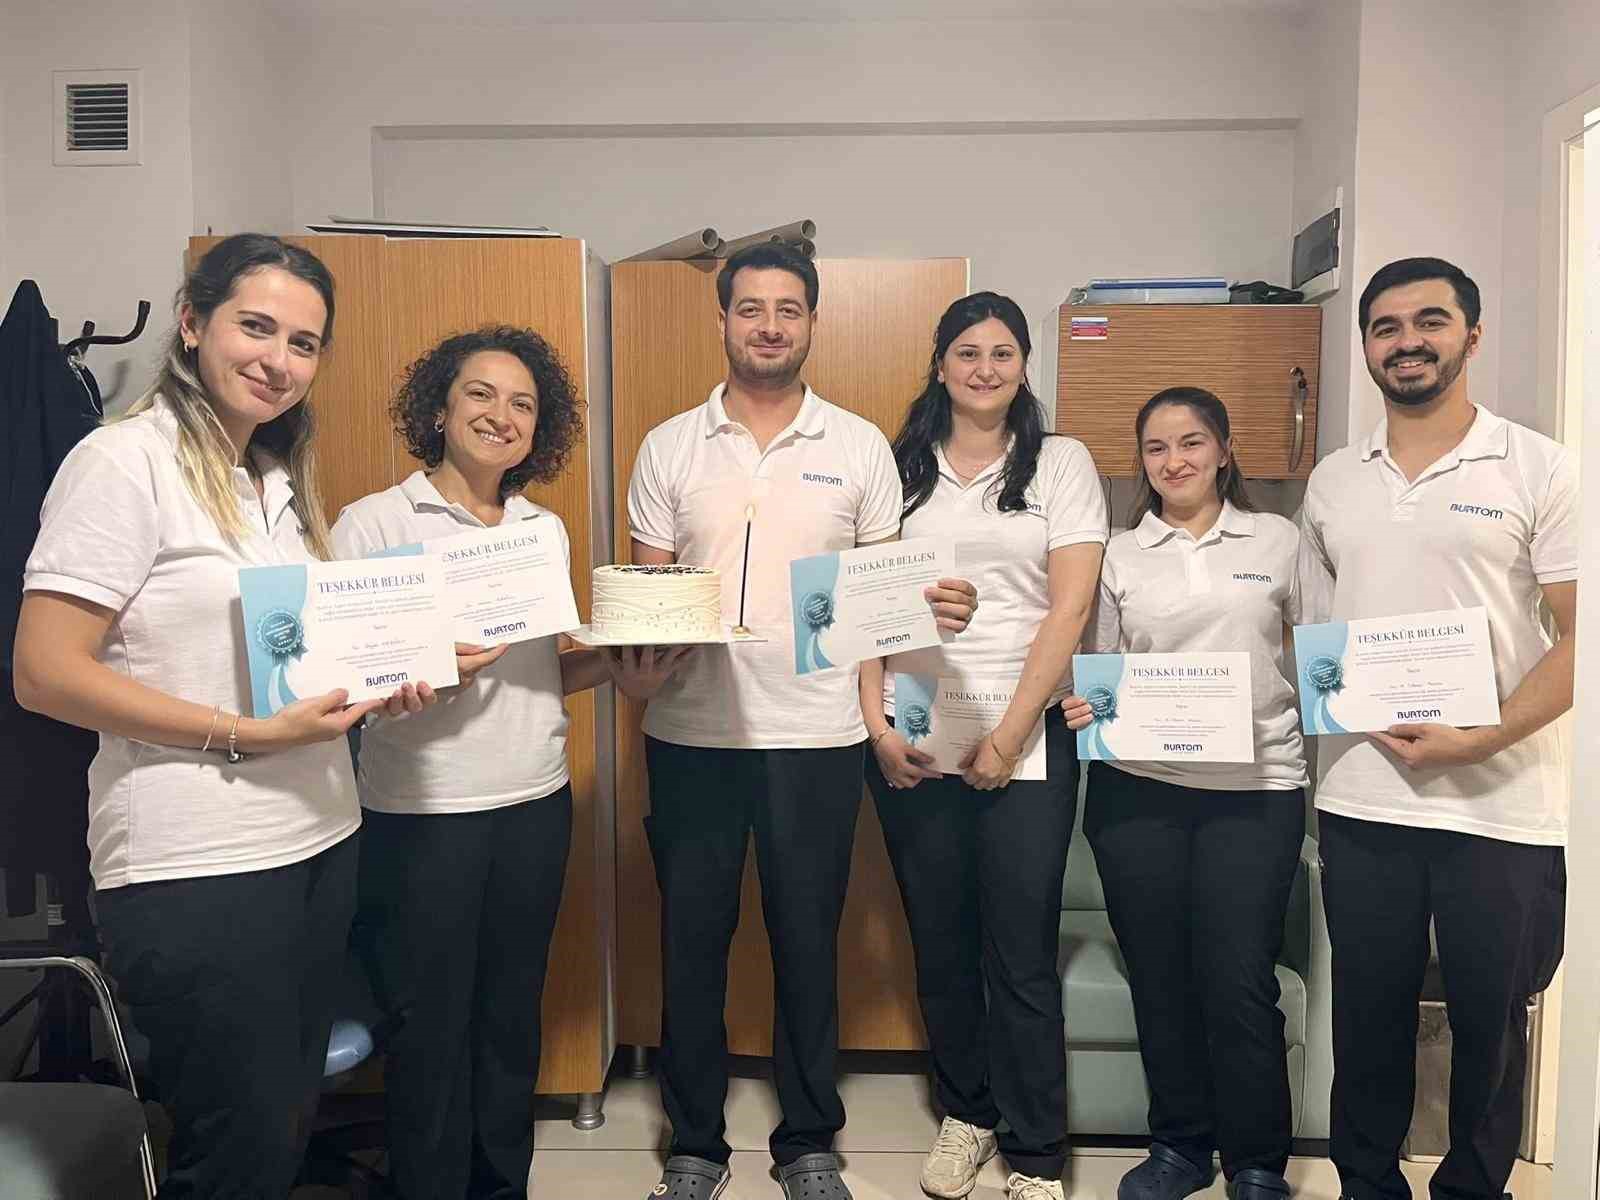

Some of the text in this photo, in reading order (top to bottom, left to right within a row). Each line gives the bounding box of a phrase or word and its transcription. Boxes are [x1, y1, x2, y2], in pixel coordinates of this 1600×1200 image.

[1450, 503, 1504, 520] BURTOM
[484, 620, 526, 637] BURTOM
[366, 671, 408, 687] BURTOM
[1397, 709, 1442, 719] BURTOM
[1163, 743, 1203, 752] BURTOM
